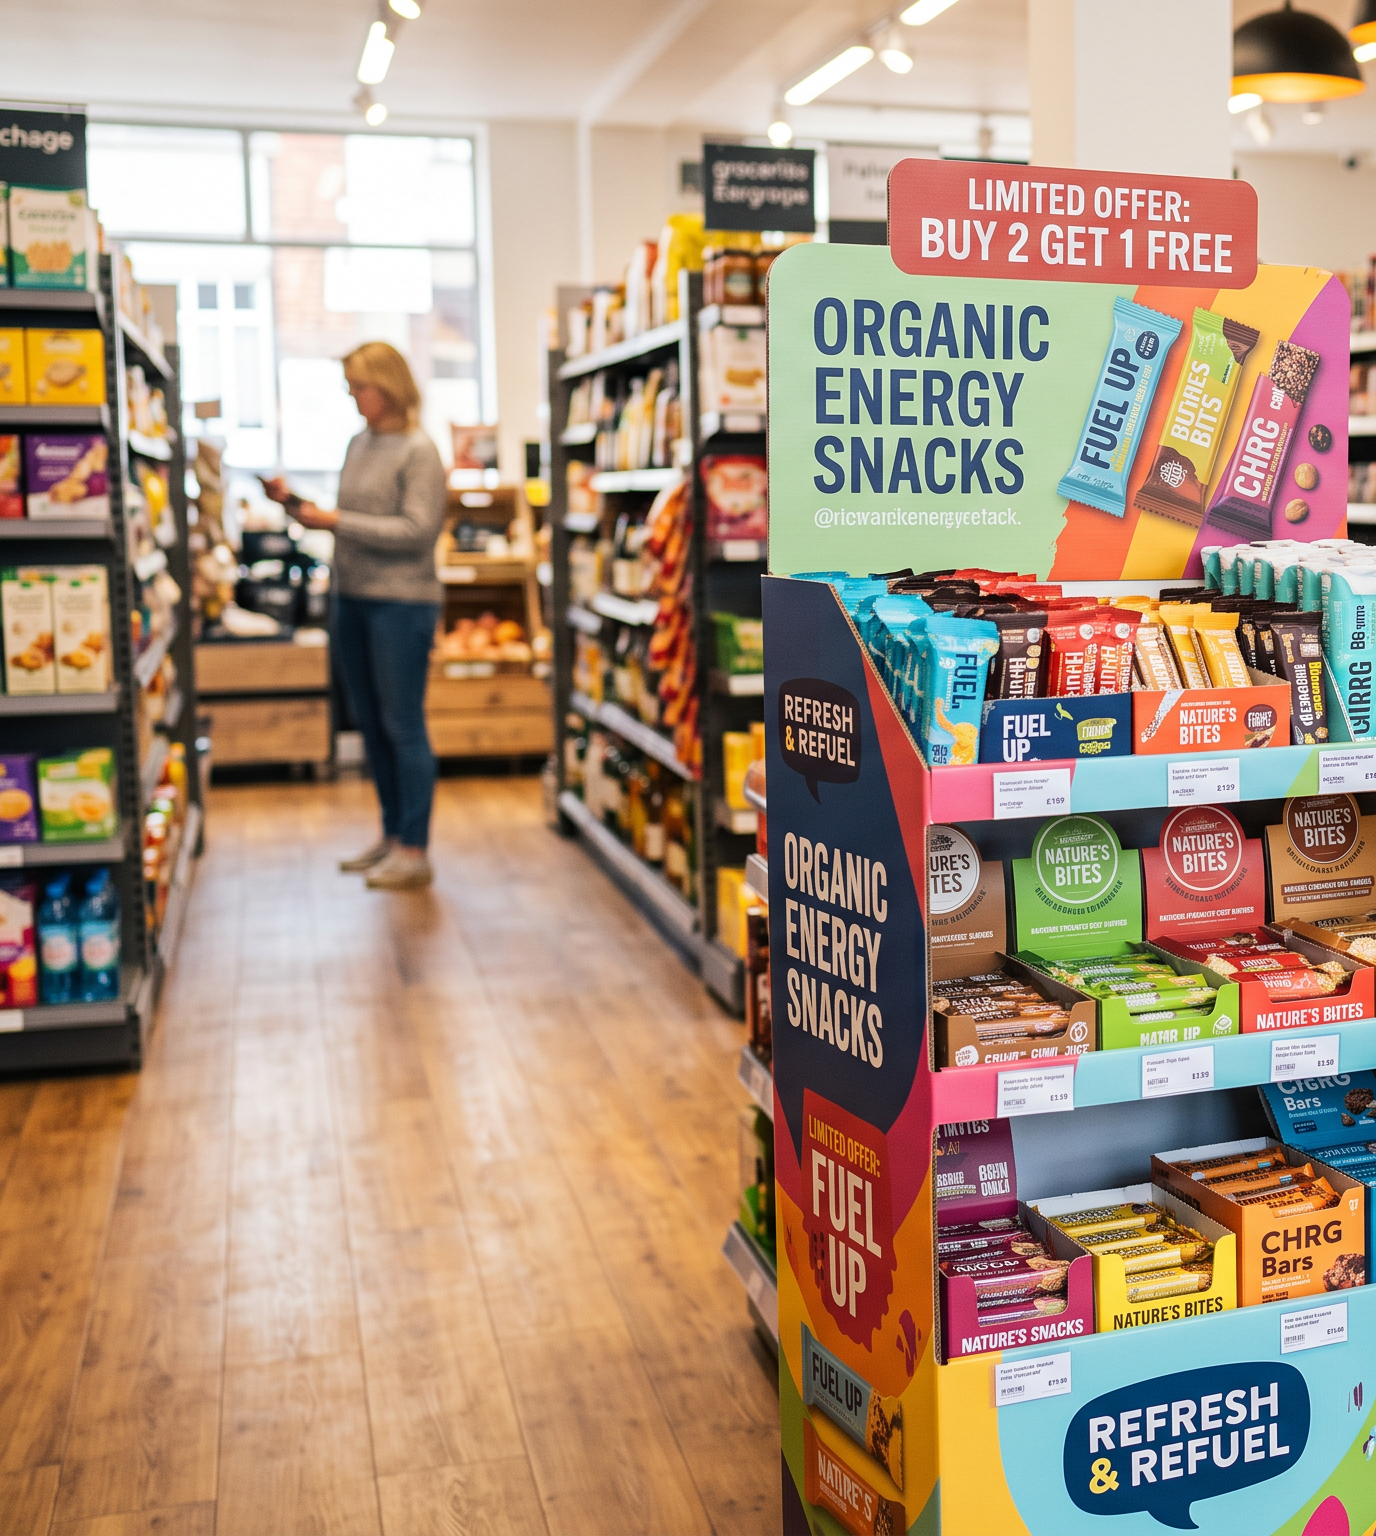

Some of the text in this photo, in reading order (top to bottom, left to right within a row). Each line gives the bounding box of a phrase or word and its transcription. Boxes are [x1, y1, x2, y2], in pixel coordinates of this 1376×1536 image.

[969, 178, 1191, 222] LIMITED OFFER:
[921, 217, 1232, 273] BUY 2 GET 1 FREE
[813, 297, 1049, 362] ORGANIC
[1104, 347, 1140, 391] UP
[814, 367, 1025, 428] ENERGY
[1080, 399, 1130, 469] FUEL
[1189, 394, 1222, 448] BITS
[813, 434, 1025, 495] SNACKS
[1233, 417, 1280, 498] CHRG
[784, 694, 853, 734] REFRESH
[1003, 713, 1051, 738] FUEL
[1179, 707, 1237, 725] NATURE'S
[1179, 724, 1221, 745] BITES
[785, 724, 856, 767] & REFUEL
[1003, 739, 1031, 762] UP
[1294, 808, 1351, 828] NATURE'S
[1304, 825, 1346, 848] BITES
[930, 853, 970, 872] URE'S
[1045, 845, 1110, 865] NATURE'S
[1172, 832, 1235, 853] NATURE'S
[1182, 851, 1228, 875] BITES
[784, 831, 888, 923] ORGANIC
[930, 872, 962, 894] TES
[1054, 863, 1102, 887] BITES
[785, 896, 882, 993] ENERGY
[786, 966, 884, 1069] SNACKS
[1256, 1008, 1320, 1030] NATURE'S
[1283, 1097, 1321, 1111] Bars
[808, 1114, 881, 1178] LIMITED OFFER:
[811, 1148, 882, 1259] FUEL
[1261, 1220, 1342, 1254] CHRG
[828, 1234, 867, 1318] UP
[1262, 1255, 1313, 1278] Bars
[1113, 1296, 1223, 1330] NATURE'S BITES
[961, 1318, 1084, 1353] NATURE'S SNACKS
[812, 1351, 863, 1417] FUEL UP
[1089, 1382, 1280, 1453] REFRESH
[1090, 1423, 1290, 1495] & REFUEL
